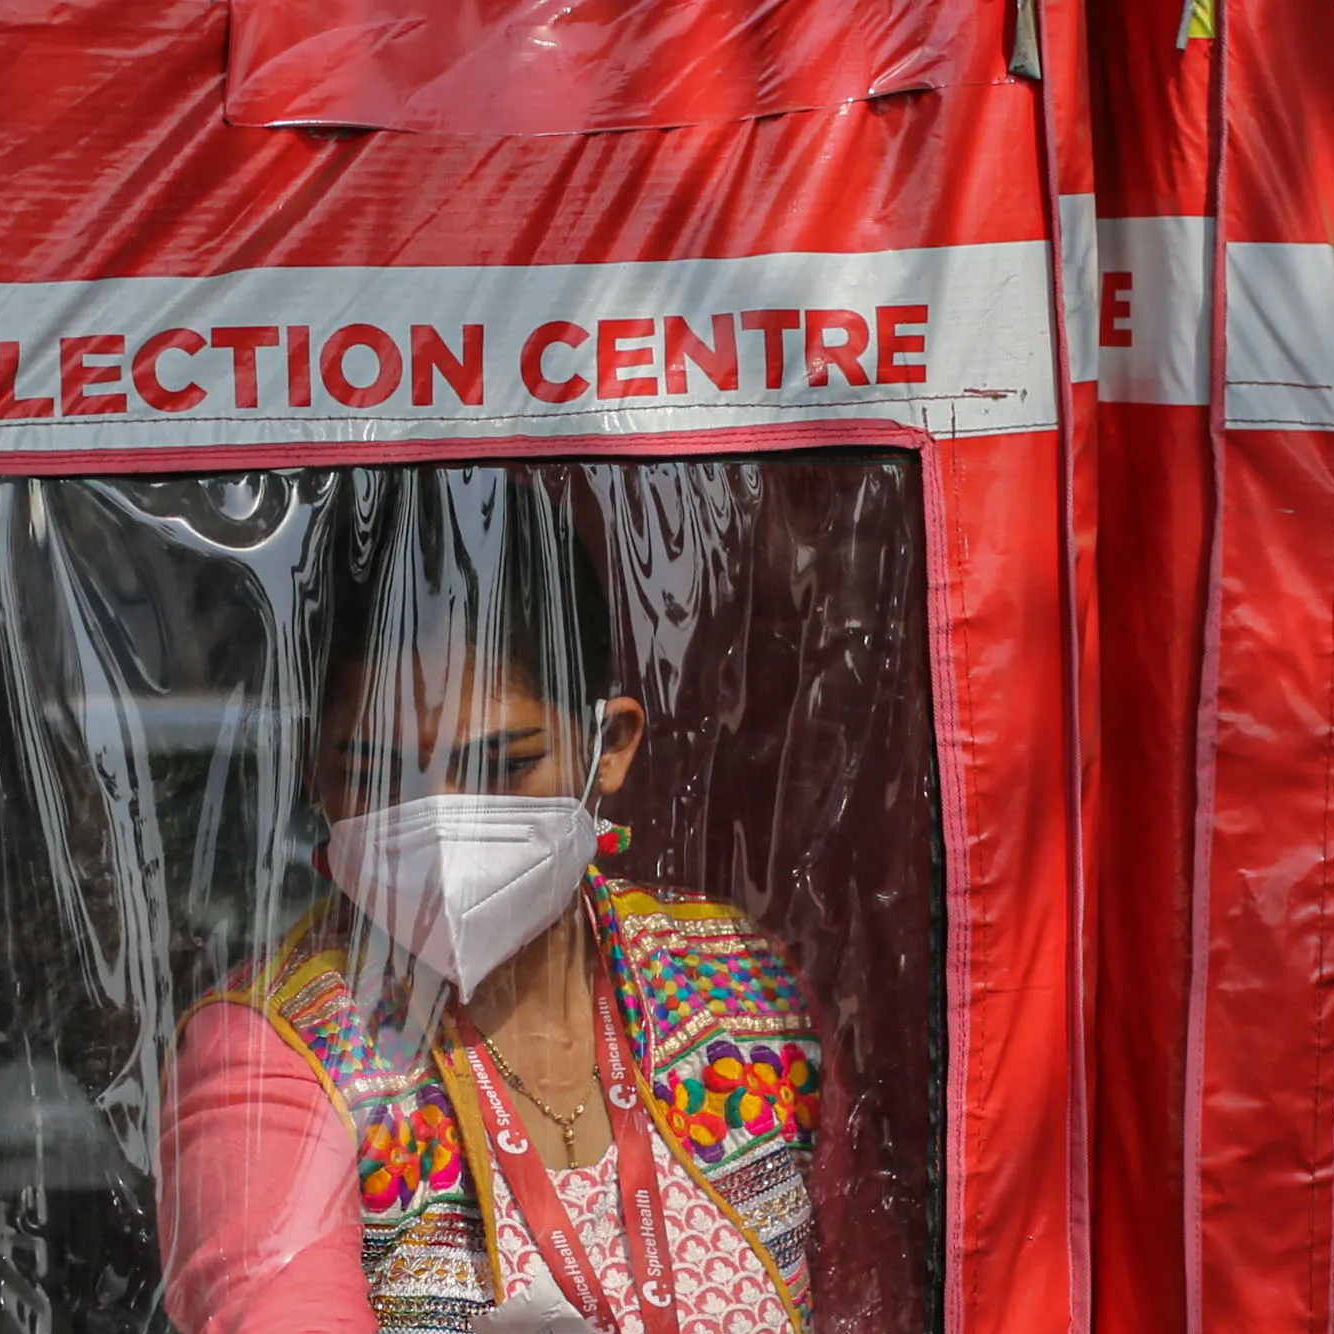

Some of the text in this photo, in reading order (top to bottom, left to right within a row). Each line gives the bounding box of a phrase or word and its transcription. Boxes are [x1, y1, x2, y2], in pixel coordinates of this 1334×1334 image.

[519, 304, 929, 402] CENTRE
[550, 1230, 598, 1312] SpiceHealth
[635, 1189, 662, 1277] SpiceHealth
